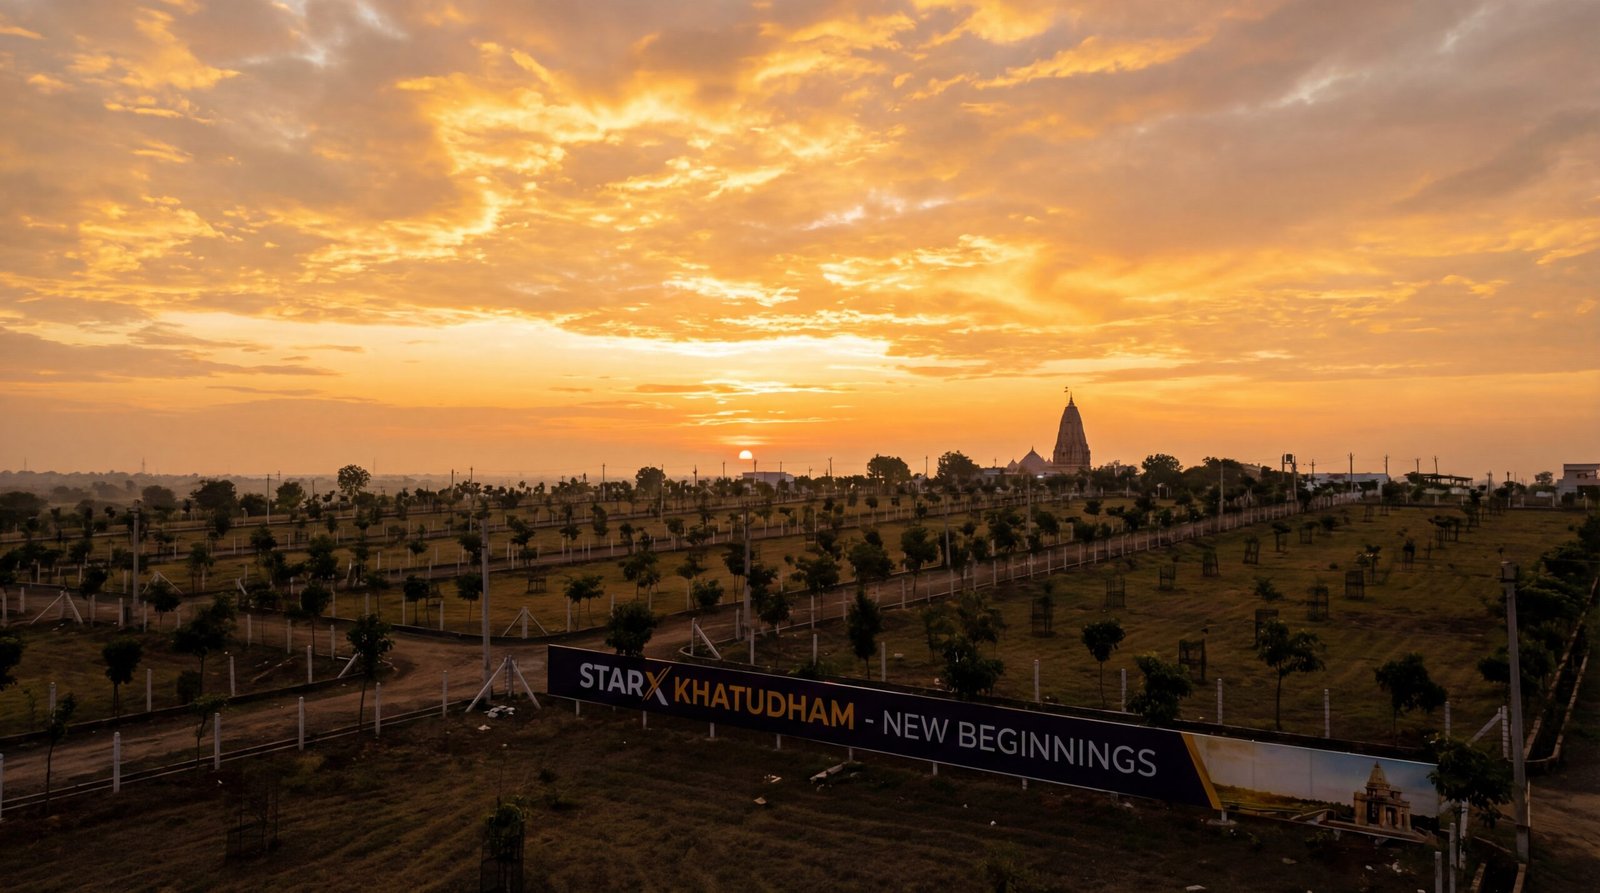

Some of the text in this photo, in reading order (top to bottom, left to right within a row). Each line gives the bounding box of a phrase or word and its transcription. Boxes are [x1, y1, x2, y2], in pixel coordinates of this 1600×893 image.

[579, 662, 672, 706] STARX
[674, 676, 855, 730] KHATUDHAM
[883, 710, 949, 744] NEW
[958, 721, 1157, 777] BEGINNINGS
